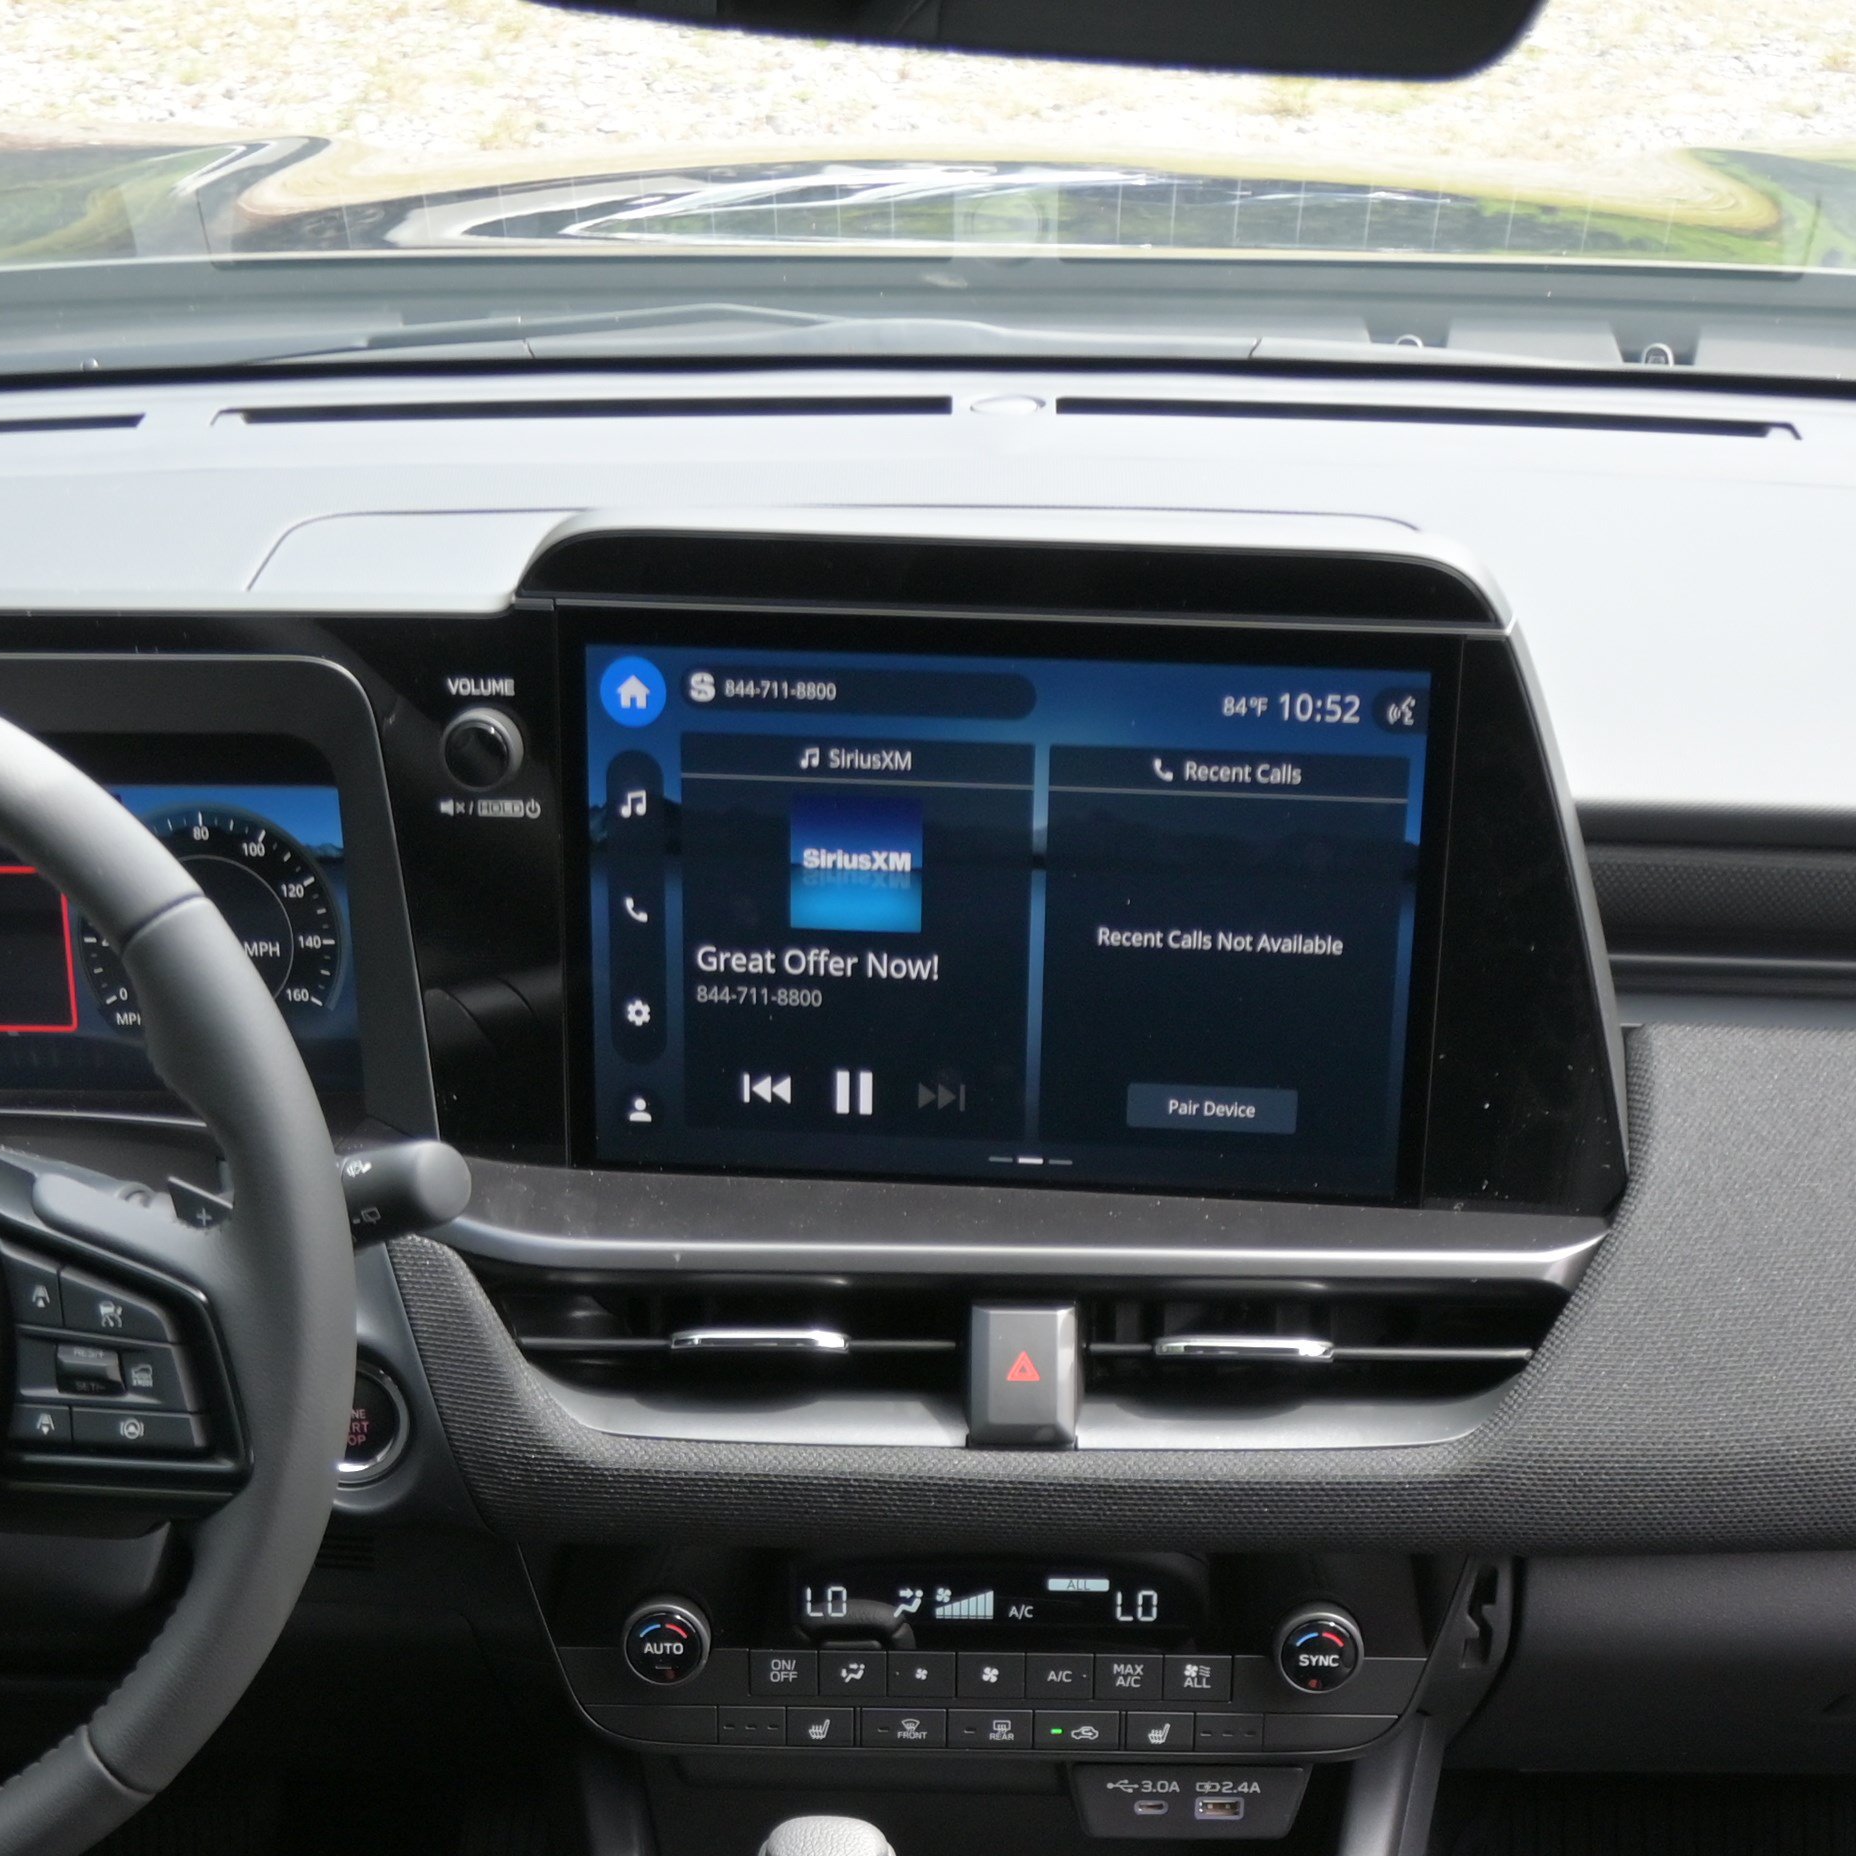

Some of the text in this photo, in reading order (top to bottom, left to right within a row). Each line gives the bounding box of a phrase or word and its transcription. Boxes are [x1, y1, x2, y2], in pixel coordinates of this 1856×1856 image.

[448, 678, 515, 697] VOLUME
[725, 680, 837, 700] 844-711-8800
[1222, 692, 1361, 724] 84°F 10:52
[829, 748, 912, 772] SiriusXM
[1185, 760, 1302, 786] Recent Calls
[193, 826, 210, 841] 80
[242, 843, 266, 858] 100
[803, 848, 912, 873] SiriusXM
[281, 884, 305, 899] 120
[298, 935, 322, 950] 140
[1097, 927, 1344, 956] Recent Calls Not Available
[245, 941, 281, 958] MPH
[696, 945, 940, 982] Great Offer Now!
[119, 988, 129, 1001] 0
[286, 988, 310, 1003] 160
[696, 985, 823, 1008] 844-711-8800
[1168, 1099, 1256, 1119] Pair Device
[1066, 1579, 1091, 1591] ALL
[1008, 1605, 1035, 1620] A/C
[644, 1642, 684, 1656] AUTO
[771, 1659, 797, 1672] ON/
[1298, 1654, 1341, 1669] SYNC
[770, 1671, 798, 1683] OFF
[1047, 1671, 1073, 1684] A/C
[1113, 1664, 1144, 1677] MAX
[1115, 1675, 1142, 1689] A/C
[1184, 1676, 1212, 1689] ALL
[897, 1731, 929, 1741] FRONT
[989, 1732, 1016, 1742] REAR
[1141, 1780, 1181, 1794] 3.0A
[1221, 1781, 1262, 1795] 2.4A
